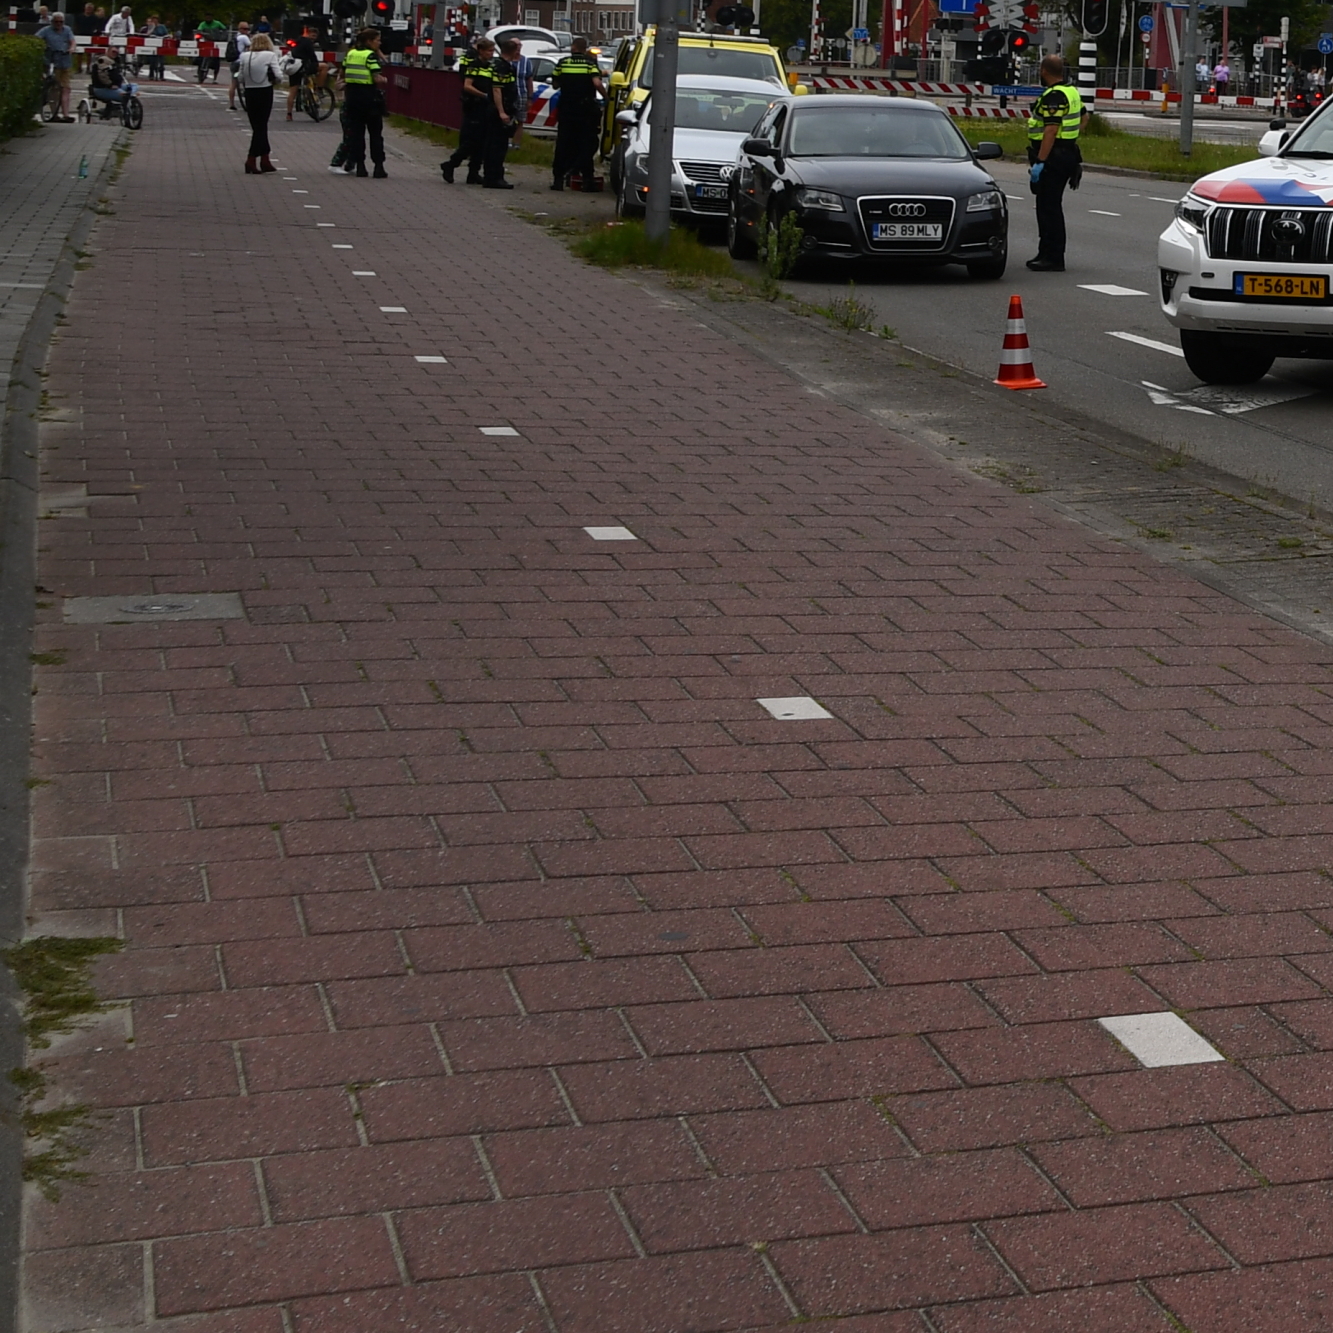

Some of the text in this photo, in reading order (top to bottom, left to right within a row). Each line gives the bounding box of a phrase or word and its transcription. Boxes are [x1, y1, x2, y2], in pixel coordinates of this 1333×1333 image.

[993, 87, 1017, 95] WACHT
[702, 187, 717, 198] MS
[879, 224, 940, 237] MS 89 MLY
[1248, 277, 1320, 296] T-568-LN
